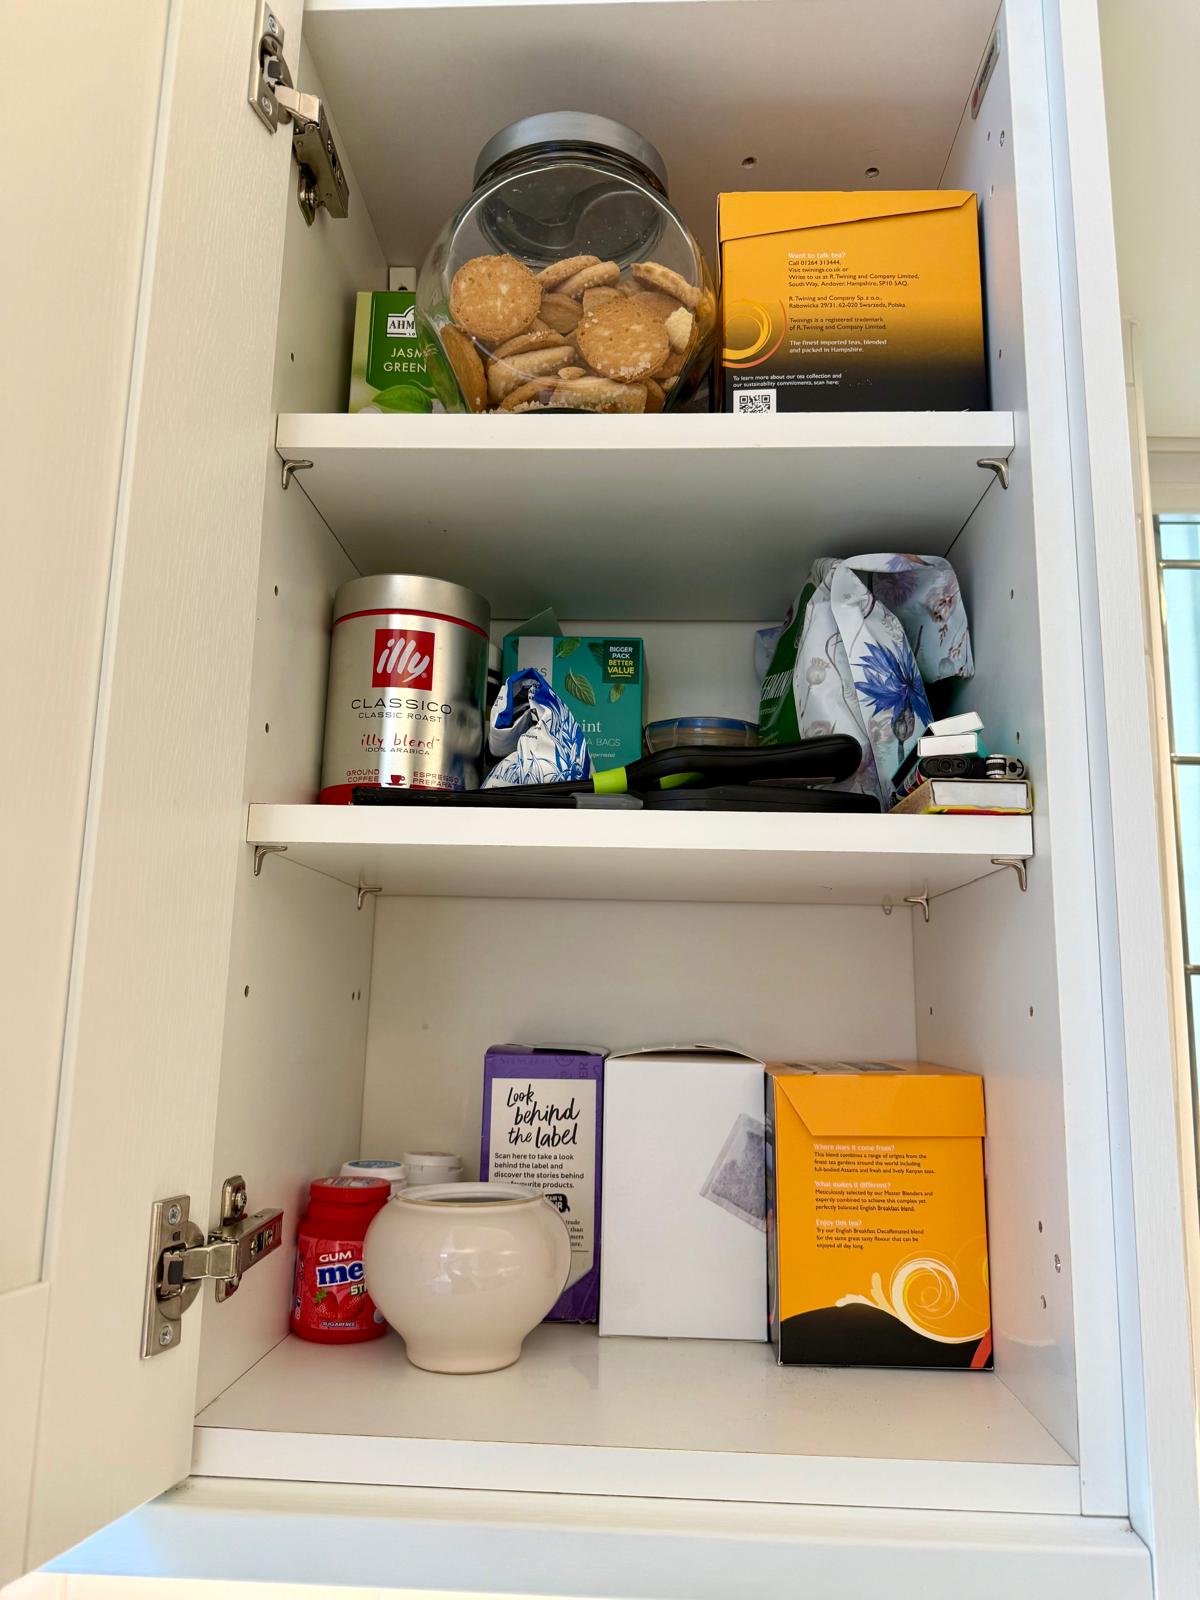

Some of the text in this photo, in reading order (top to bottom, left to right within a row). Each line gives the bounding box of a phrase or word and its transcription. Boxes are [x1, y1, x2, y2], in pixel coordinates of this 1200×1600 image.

[383, 362, 427, 373] GREEN
[377, 638, 430, 682] illy
[351, 698, 452, 715] CLASSICO
[407, 713, 442, 722] ROAST
[361, 734, 384, 748] illy
[596, 738, 621, 746] BAGS
[413, 771, 458, 783] ESPRESSO
[507, 1084, 534, 1107] Look
[514, 1098, 580, 1126] behind
[508, 1123, 578, 1148] the label
[319, 1251, 352, 1262] GUM
[317, 1262, 364, 1286] me
